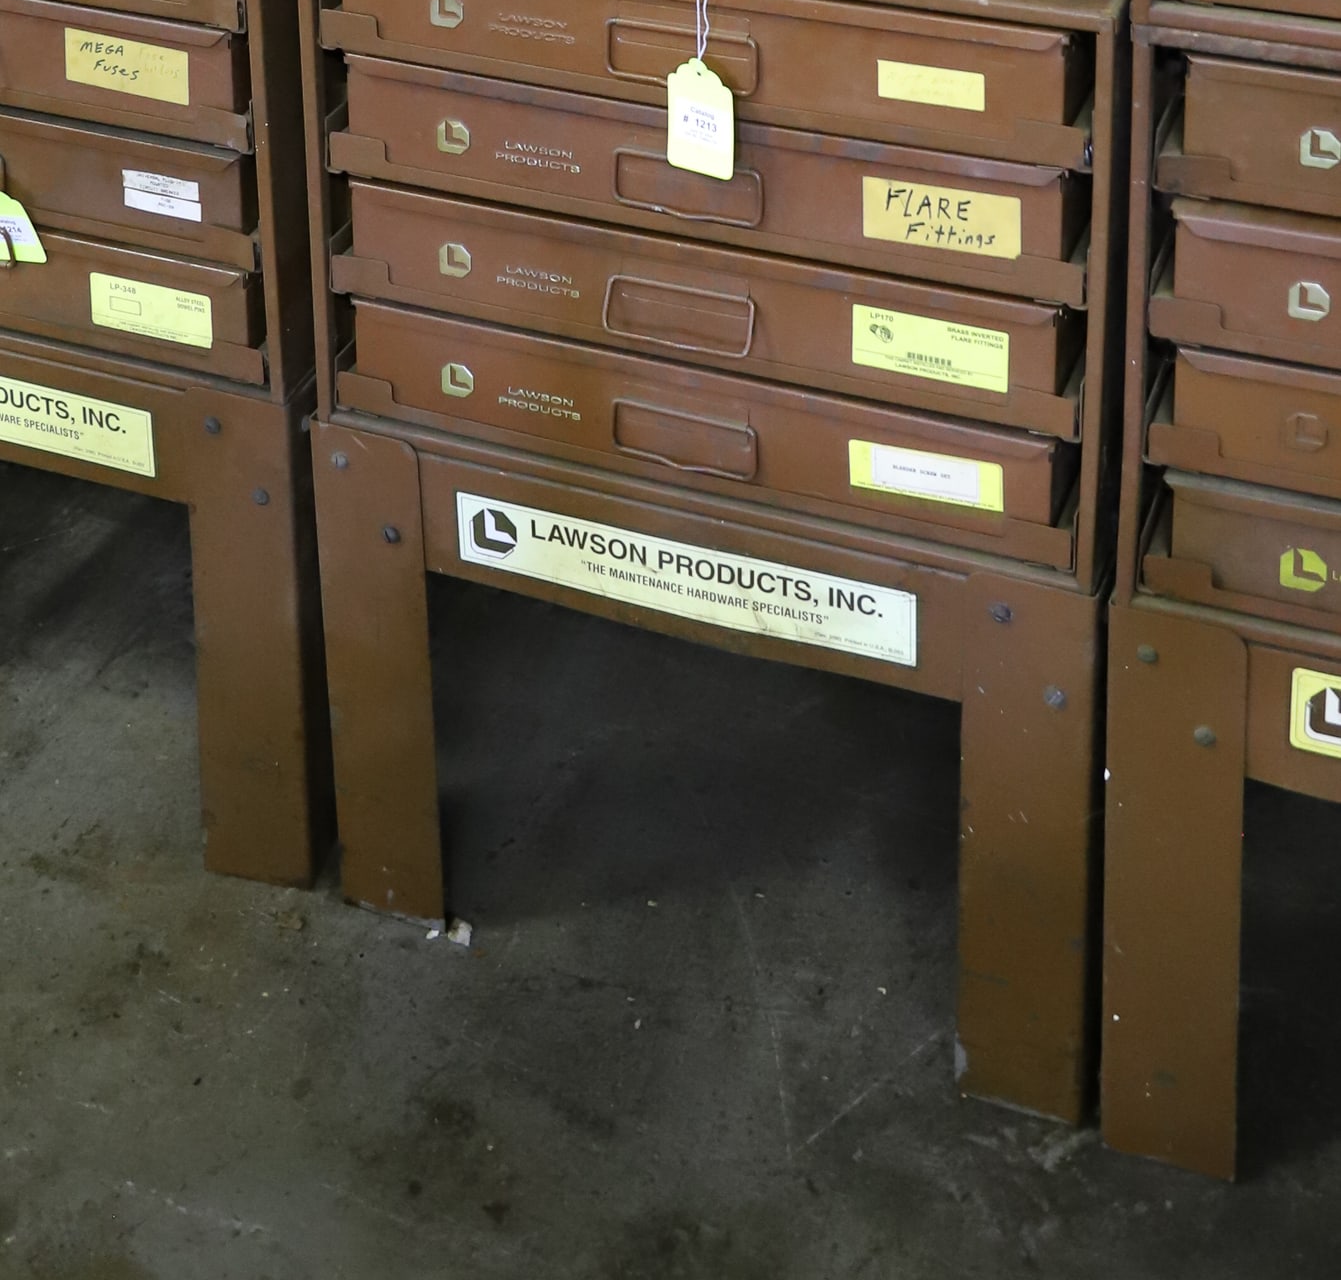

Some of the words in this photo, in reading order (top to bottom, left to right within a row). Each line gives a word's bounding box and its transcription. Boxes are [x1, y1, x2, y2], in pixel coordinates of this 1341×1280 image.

[499, 13, 568, 29] LAWSON
[489, 23, 575, 45] PRODUCTS
[80, 42, 124, 56] MEGA
[696, 119, 716, 132] 1213
[505, 140, 573, 159] LAWSON
[495, 152, 581, 174] PRODUCTS
[886, 187, 971, 221] FLARE
[506, 265, 572, 284] LAWSON
[497, 276, 580, 298] PRODUCTS
[191, 299, 204, 307] STEEL
[870, 312, 894, 322] LP170
[947, 327, 969, 336] BRASS
[971, 331, 1004, 342] INVERTED
[951, 335, 972, 343] FLARE
[974, 339, 1003, 349] FITTINGS
[508, 386, 574, 407] LAWSON
[499, 396, 581, 421] PRODUCTS
[83, 407, 127, 434] INC.
[530, 519, 647, 566] LAWSON
[658, 550, 818, 608] PRODUCTS,
[829, 587, 883, 618] INC.
[609, 567, 684, 595] MAINTENANCE
[687, 587, 749, 610] HARDWARE
